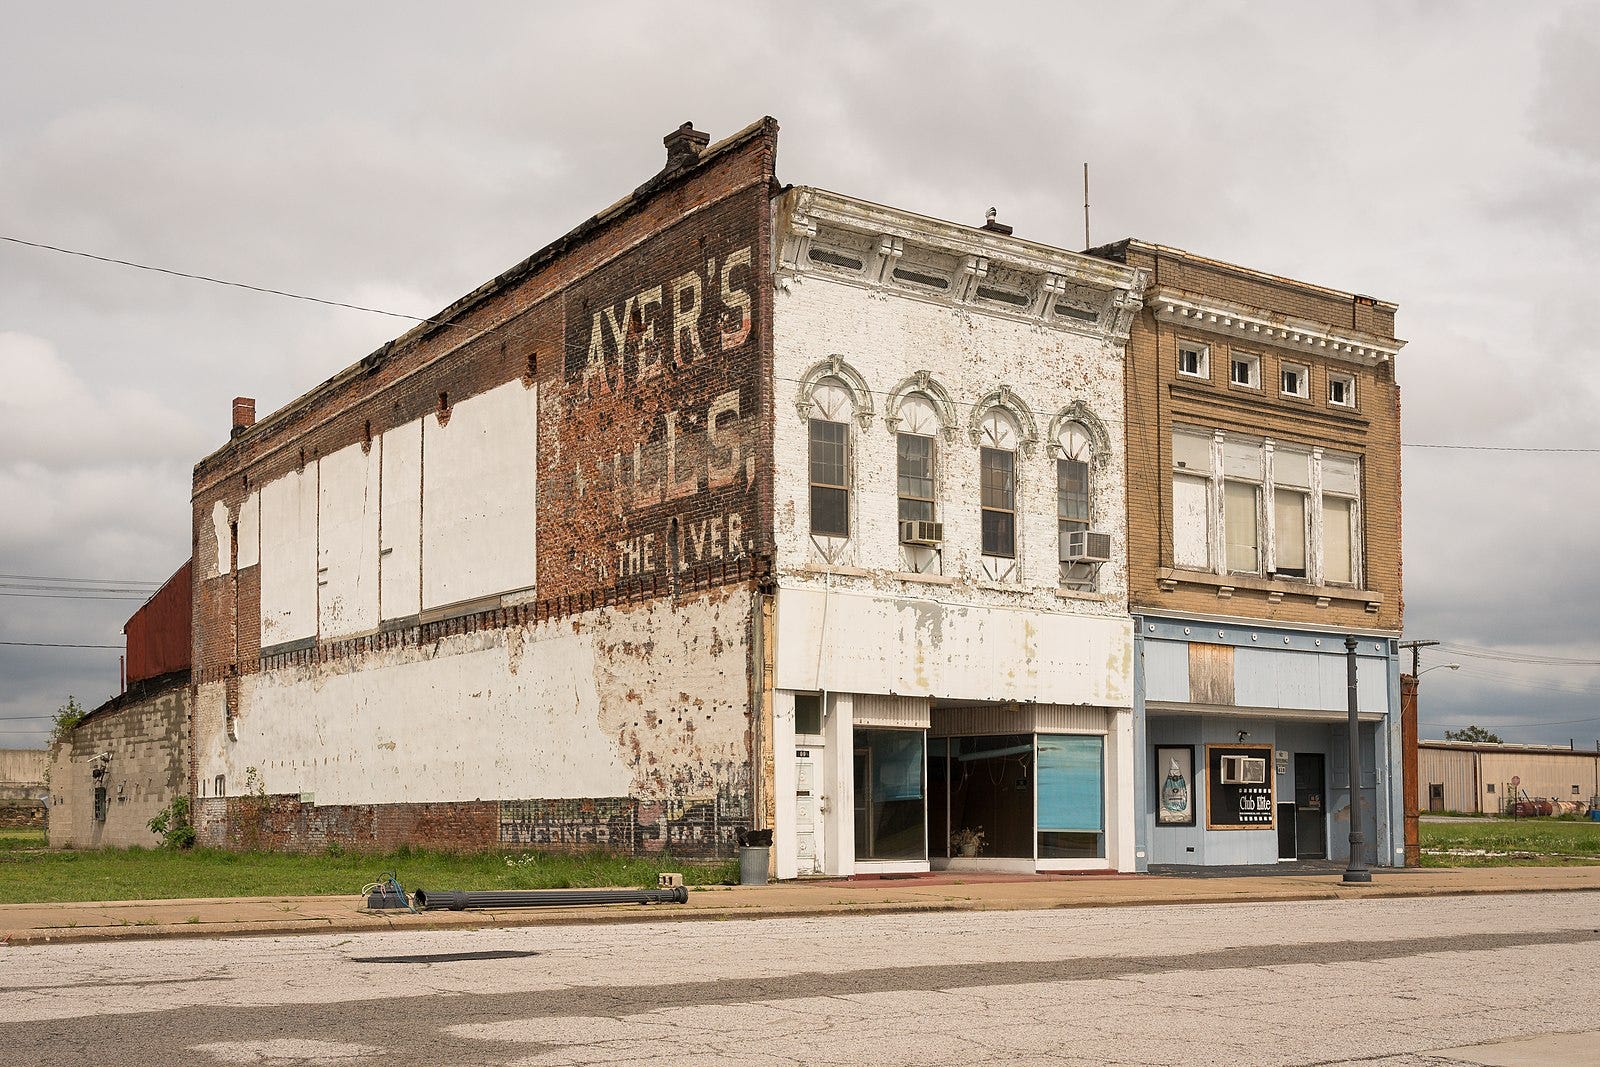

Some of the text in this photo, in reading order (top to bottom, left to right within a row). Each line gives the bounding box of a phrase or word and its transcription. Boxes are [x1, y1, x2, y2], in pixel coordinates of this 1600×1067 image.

[583, 246, 751, 396] AYER'S
[574, 389, 755, 513] ILLS,
[616, 533, 655, 577] THE
[665, 512, 754, 575] VER.
